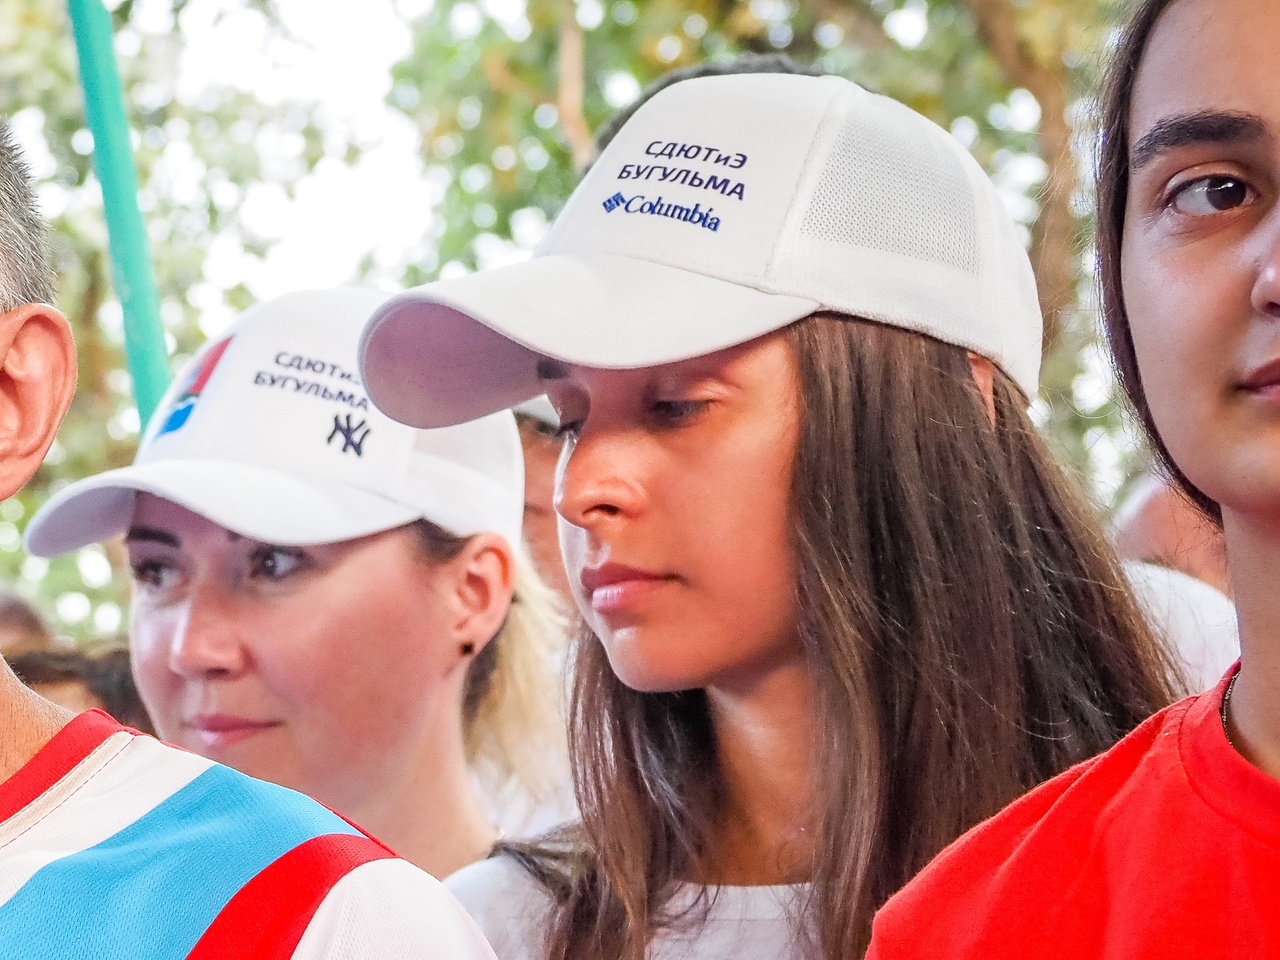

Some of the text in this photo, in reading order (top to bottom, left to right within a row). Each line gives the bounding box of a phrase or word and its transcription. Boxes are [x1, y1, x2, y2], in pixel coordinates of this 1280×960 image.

[645, 140, 748, 169] СДЮТиЭ
[617, 164, 746, 201] БУГУЛЬМА
[624, 195, 722, 232] Columbia
[275, 351, 361, 385] СДЮТи
[254, 371, 368, 411] БУГУЛЬМА
